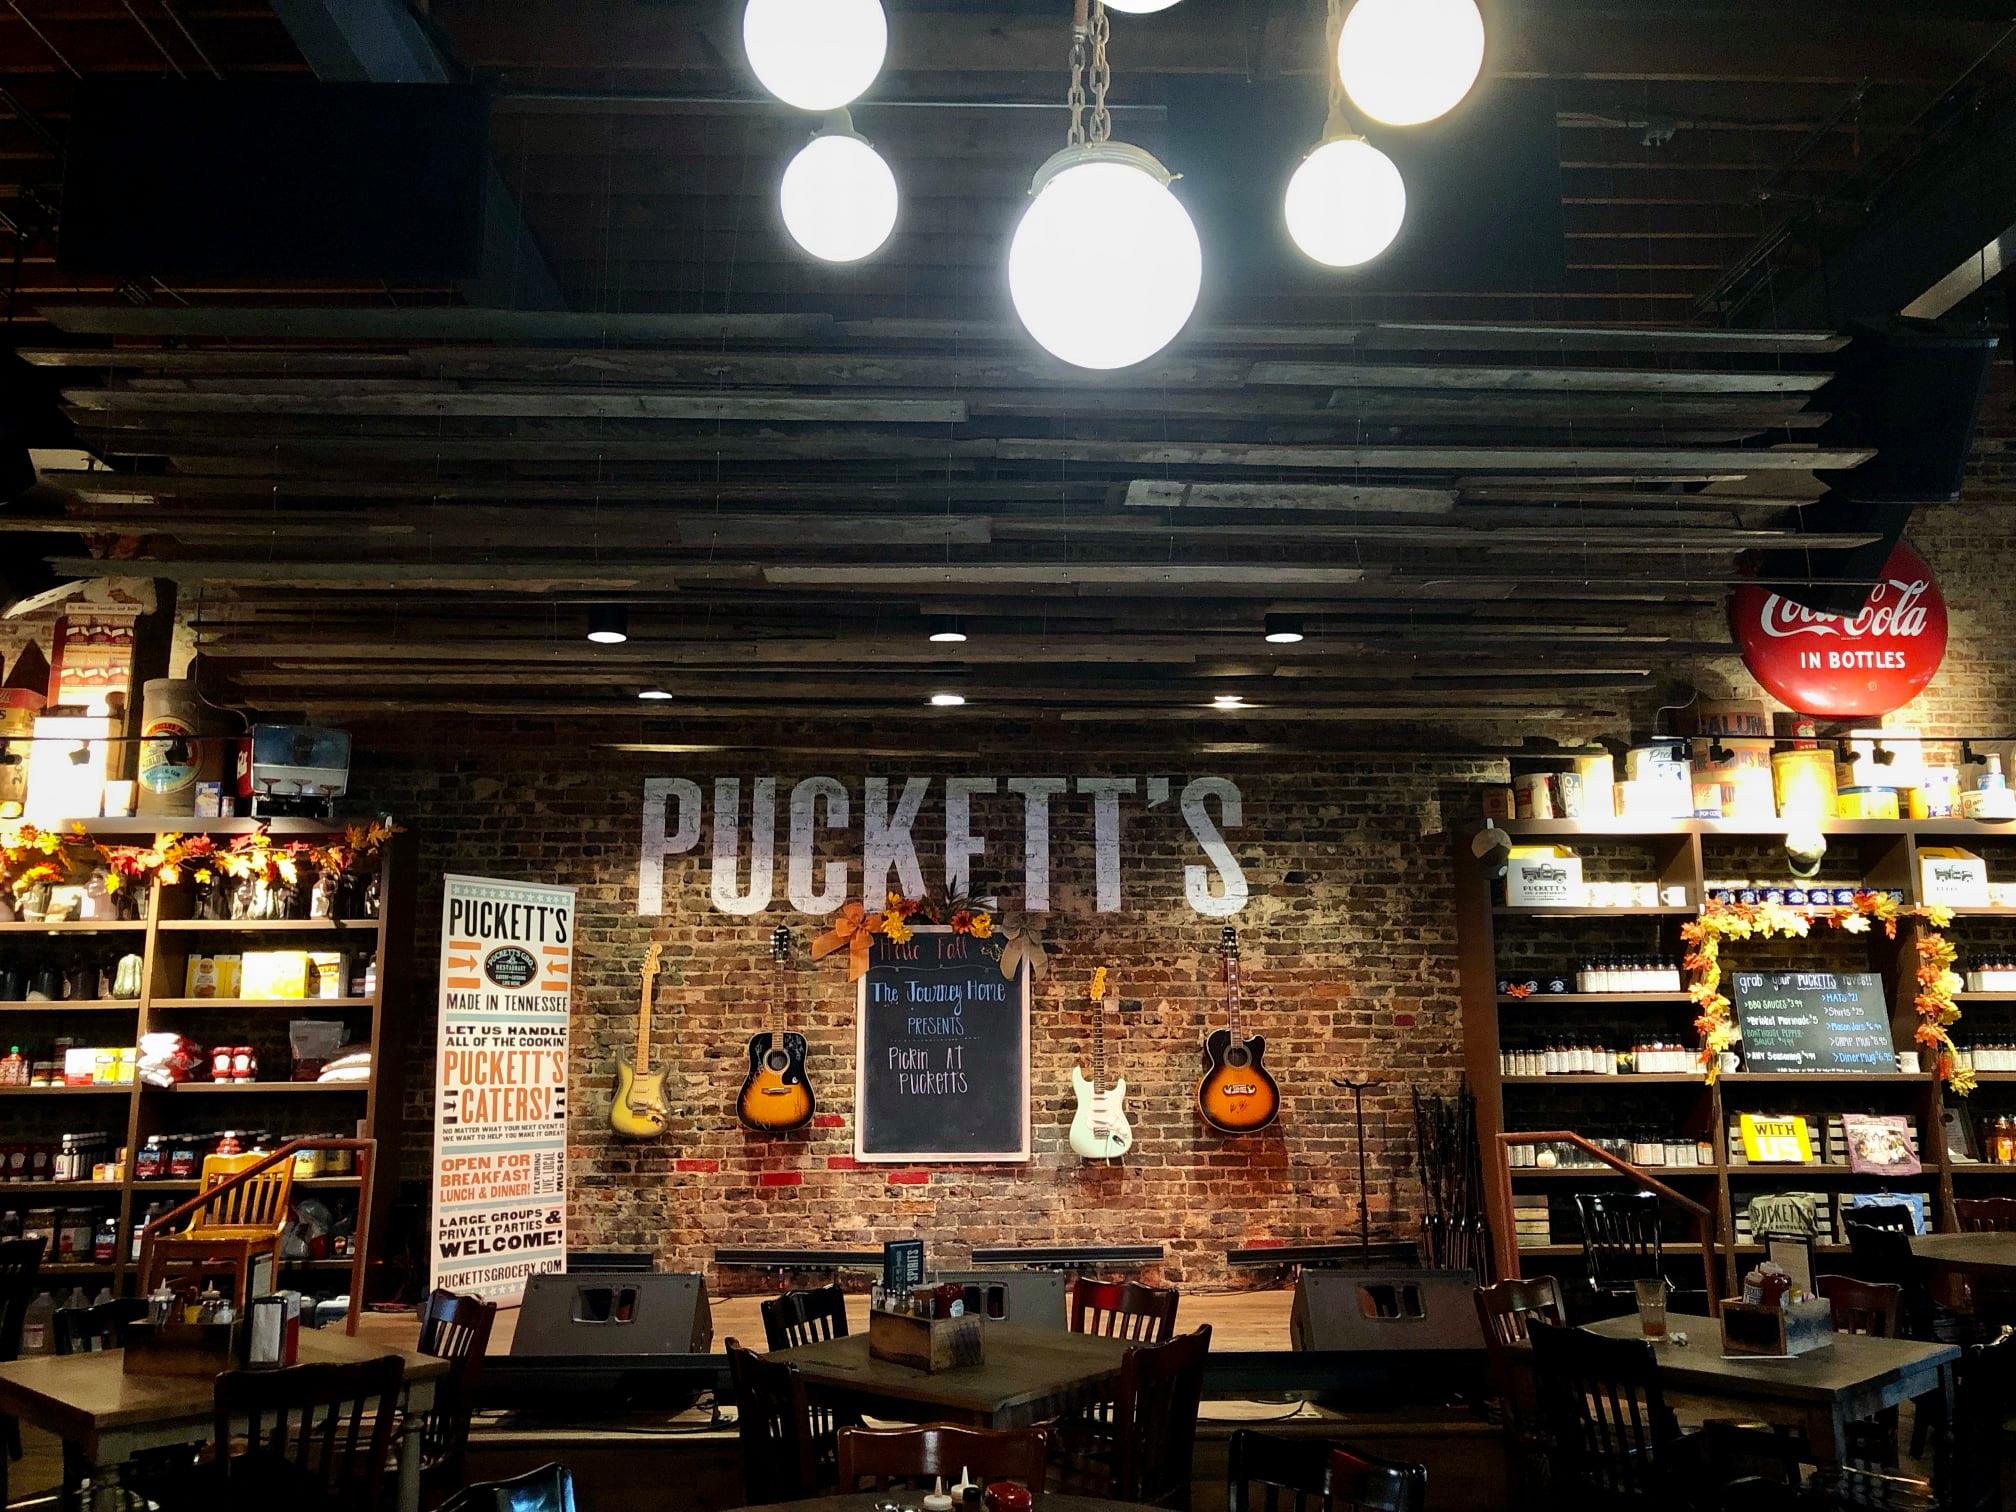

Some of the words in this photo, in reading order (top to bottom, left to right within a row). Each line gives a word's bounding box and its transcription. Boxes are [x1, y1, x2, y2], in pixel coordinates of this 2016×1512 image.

[1801, 651, 1821, 669] IN
[1829, 651, 1906, 669] BOTTLES
[638, 776, 1249, 916] PUCKETT'S
[450, 898, 567, 943] PUCKETT'S
[938, 935, 968, 960] Fall
[1740, 974, 1763, 994] grab
[1772, 975, 1791, 991] your
[446, 993, 481, 1010] MADE
[486, 994, 498, 1011] IN
[505, 995, 567, 1012] TENNESSEE
[870, 981, 899, 1002] The
[904, 980, 963, 1016] Journey
[967, 979, 1006, 1002] Home
[446, 1026, 476, 1035] LET
[481, 1026, 502, 1035] US
[508, 1026, 566, 1035] HANDLE
[908, 1016, 964, 1036] PRESENTS
[446, 1037, 469, 1047] ALL
[473, 1037, 487, 1047] OF
[492, 1037, 515, 1047] THE
[516, 1037, 566, 1047] COOKIN'
[444, 1050, 564, 1086] PUCKETT'S
[461, 1086, 551, 1124] CATERS!
[1754, 1123, 1796, 1136] WITH
[1756, 1137, 1802, 1161] US
[441, 1156, 491, 1171] OPEN
[497, 1154, 530, 1168] FOR
[533, 1152, 541, 1194] FEATURING
[543, 1152, 555, 1175] LOCAL
[556, 1151, 564, 1192] MUSIC
[440, 1168, 530, 1187] BREAKFAST
[542, 1176, 554, 1194] LIVE
[440, 1187, 475, 1203] LUNCH
[478, 1186, 487, 1199] &
[490, 1183, 530, 1198] DINNER!
[440, 1214, 486, 1228] LARGE
[491, 1209, 542, 1223] GROUPS
[545, 1210, 562, 1225] &
[439, 1225, 492, 1241] PRIVATE
[495, 1220, 542, 1235] PARTIES
[440, 1230, 563, 1259] WELCOME!
[437, 1259, 562, 1289] PUCKETTSGROCERY.COM
[907, 1249, 919, 1282] SPIRITS
